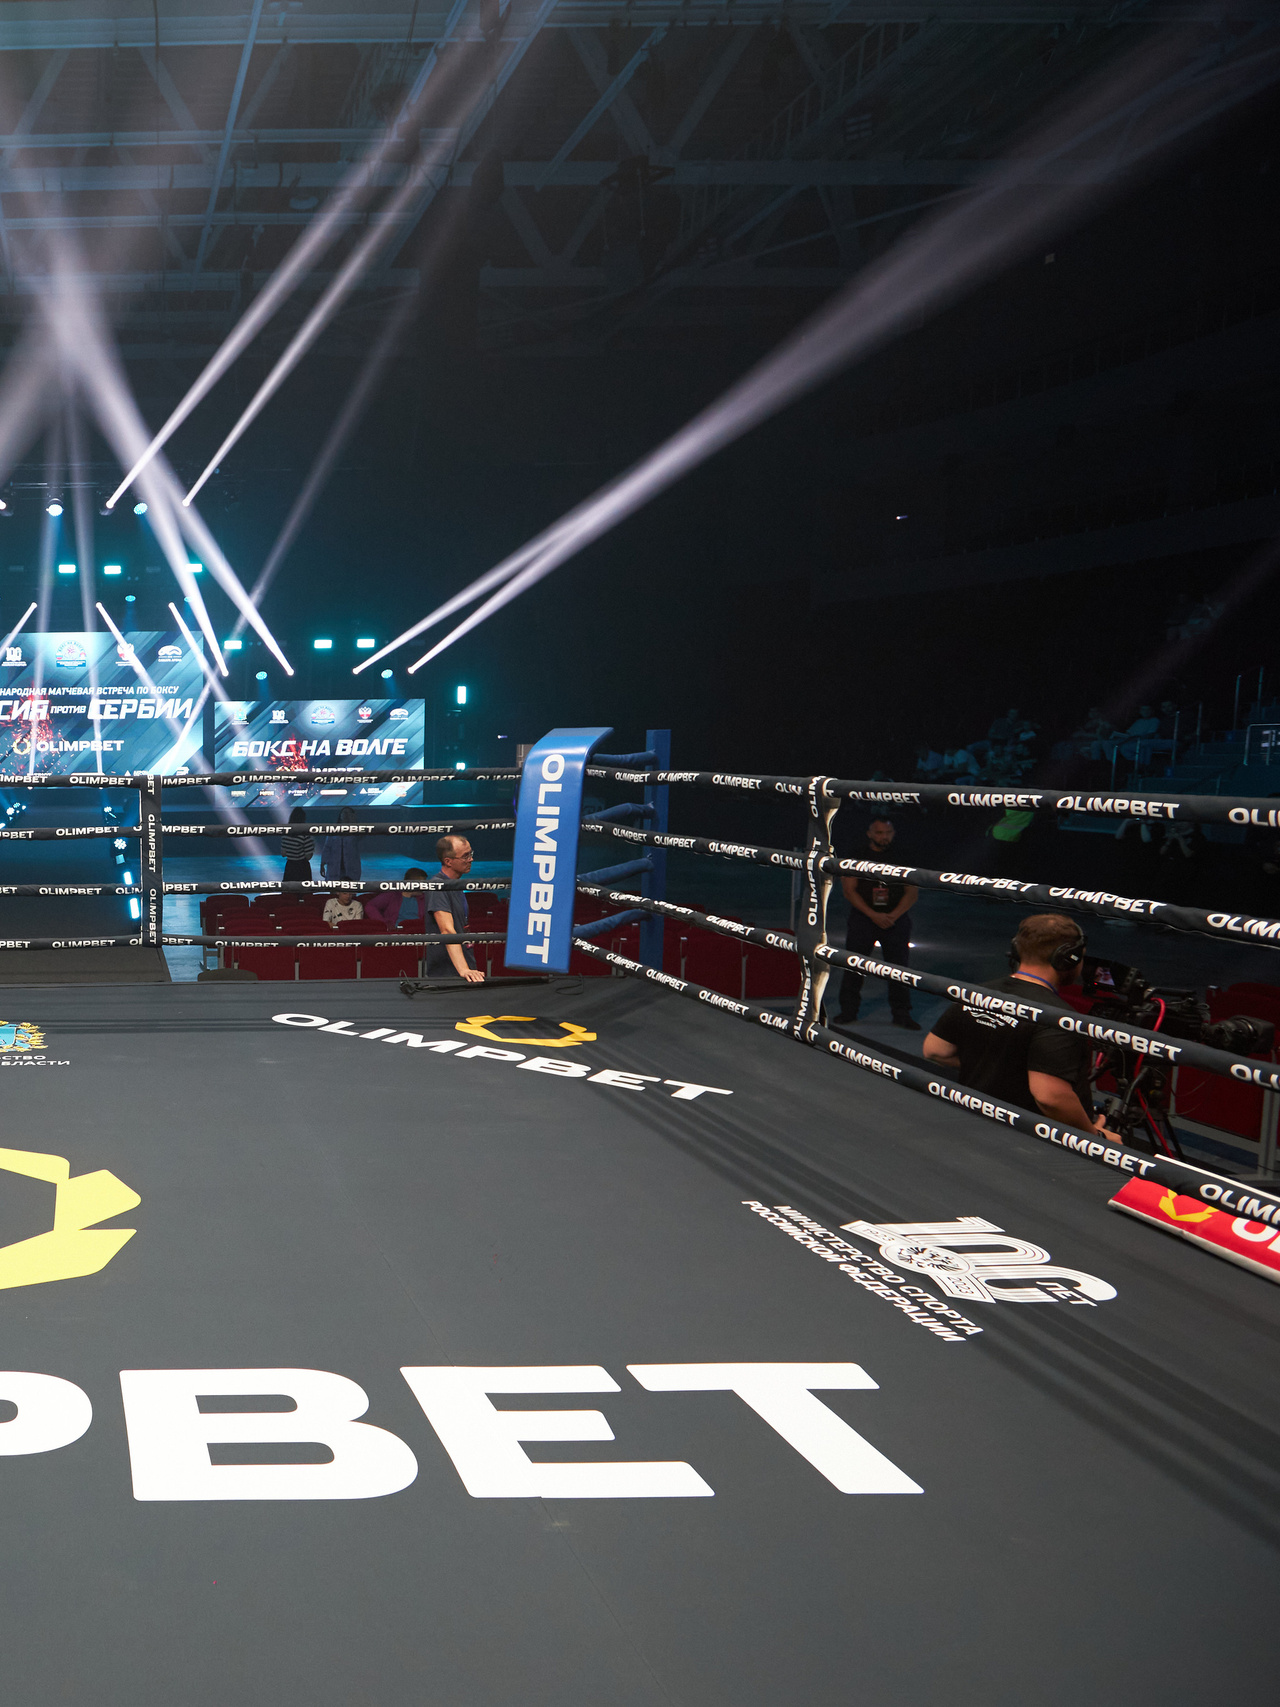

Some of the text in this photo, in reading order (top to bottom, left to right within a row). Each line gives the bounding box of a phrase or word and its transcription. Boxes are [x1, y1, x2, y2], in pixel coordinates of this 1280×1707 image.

[48, 687, 94, 696] МАТЧЕВАЯ
[97, 687, 134, 695] ВСТРЕЧА
[151, 686, 179, 694] БОКСУ
[51, 706, 86, 714] ПРОТИВ
[87, 699, 193, 719] СЕРБИИ
[37, 740, 124, 751] OLIMPBET
[232, 738, 408, 757] БОКС НА ВОЛГЕ
[70, 777, 133, 785] OLIMPBET
[615, 772, 650, 783] OLIMPBET
[658, 772, 699, 782] OLIMPBET
[712, 775, 761, 790] OLIMPBET
[947, 792, 1042, 809] OLIMPBET
[1057, 796, 1179, 819] OLIMPBET
[56, 827, 119, 836] OLIMPBET
[227, 826, 291, 835] OLIMPBET
[309, 825, 374, 833] OLIMPBET
[388, 825, 453, 833] OLIMPBET
[525, 754, 564, 963] OLIMPBET
[613, 828, 647, 842] OLIMPBET
[654, 836, 696, 848] OLIMPBET
[709, 842, 758, 858] OLIMPBET
[840, 859, 916, 878] OLIMPBET
[939, 872, 1039, 893] OLIMPBET
[1049, 887, 1167, 914] OLIMPBET
[39, 886, 101, 895] OLIMPBET
[220, 881, 282, 890] OLIMPBET
[301, 880, 365, 889] OLIMPBET
[380, 882, 444, 890] OLIMPBET
[52, 940, 115, 948] OLIMPBET
[794, 955, 811, 1040] OLIMPBET
[808, 837, 821, 925] OLIMPBET
[706, 915, 754, 936] OLIMPBET
[847, 955, 921, 987] OLIMPBET
[947, 985, 1042, 1022] OLIMPBET
[1058, 1016, 1181, 1061] OLIMPBET
[271, 1013, 733, 1100] OLIMPBET
[606, 953, 642, 971] OLIMPBET
[646, 969, 687, 991] OLIMPBET
[699, 990, 749, 1015] OLIMPBET
[829, 1041, 902, 1080] OLIMPBET
[928, 1081, 1019, 1126] OLIMPBET
[1035, 1123, 1156, 1176] OLIMPBET
[741, 1200, 966, 1342] РОССИЙСКОЙ ФЕДЕРАЦИИ
[773, 1205, 984, 1336] МИНИСТЕРСТВО СПОРТА
[947, 1275, 975, 1295] 2023
[1035, 1281, 1098, 1307] ЛЕТ
